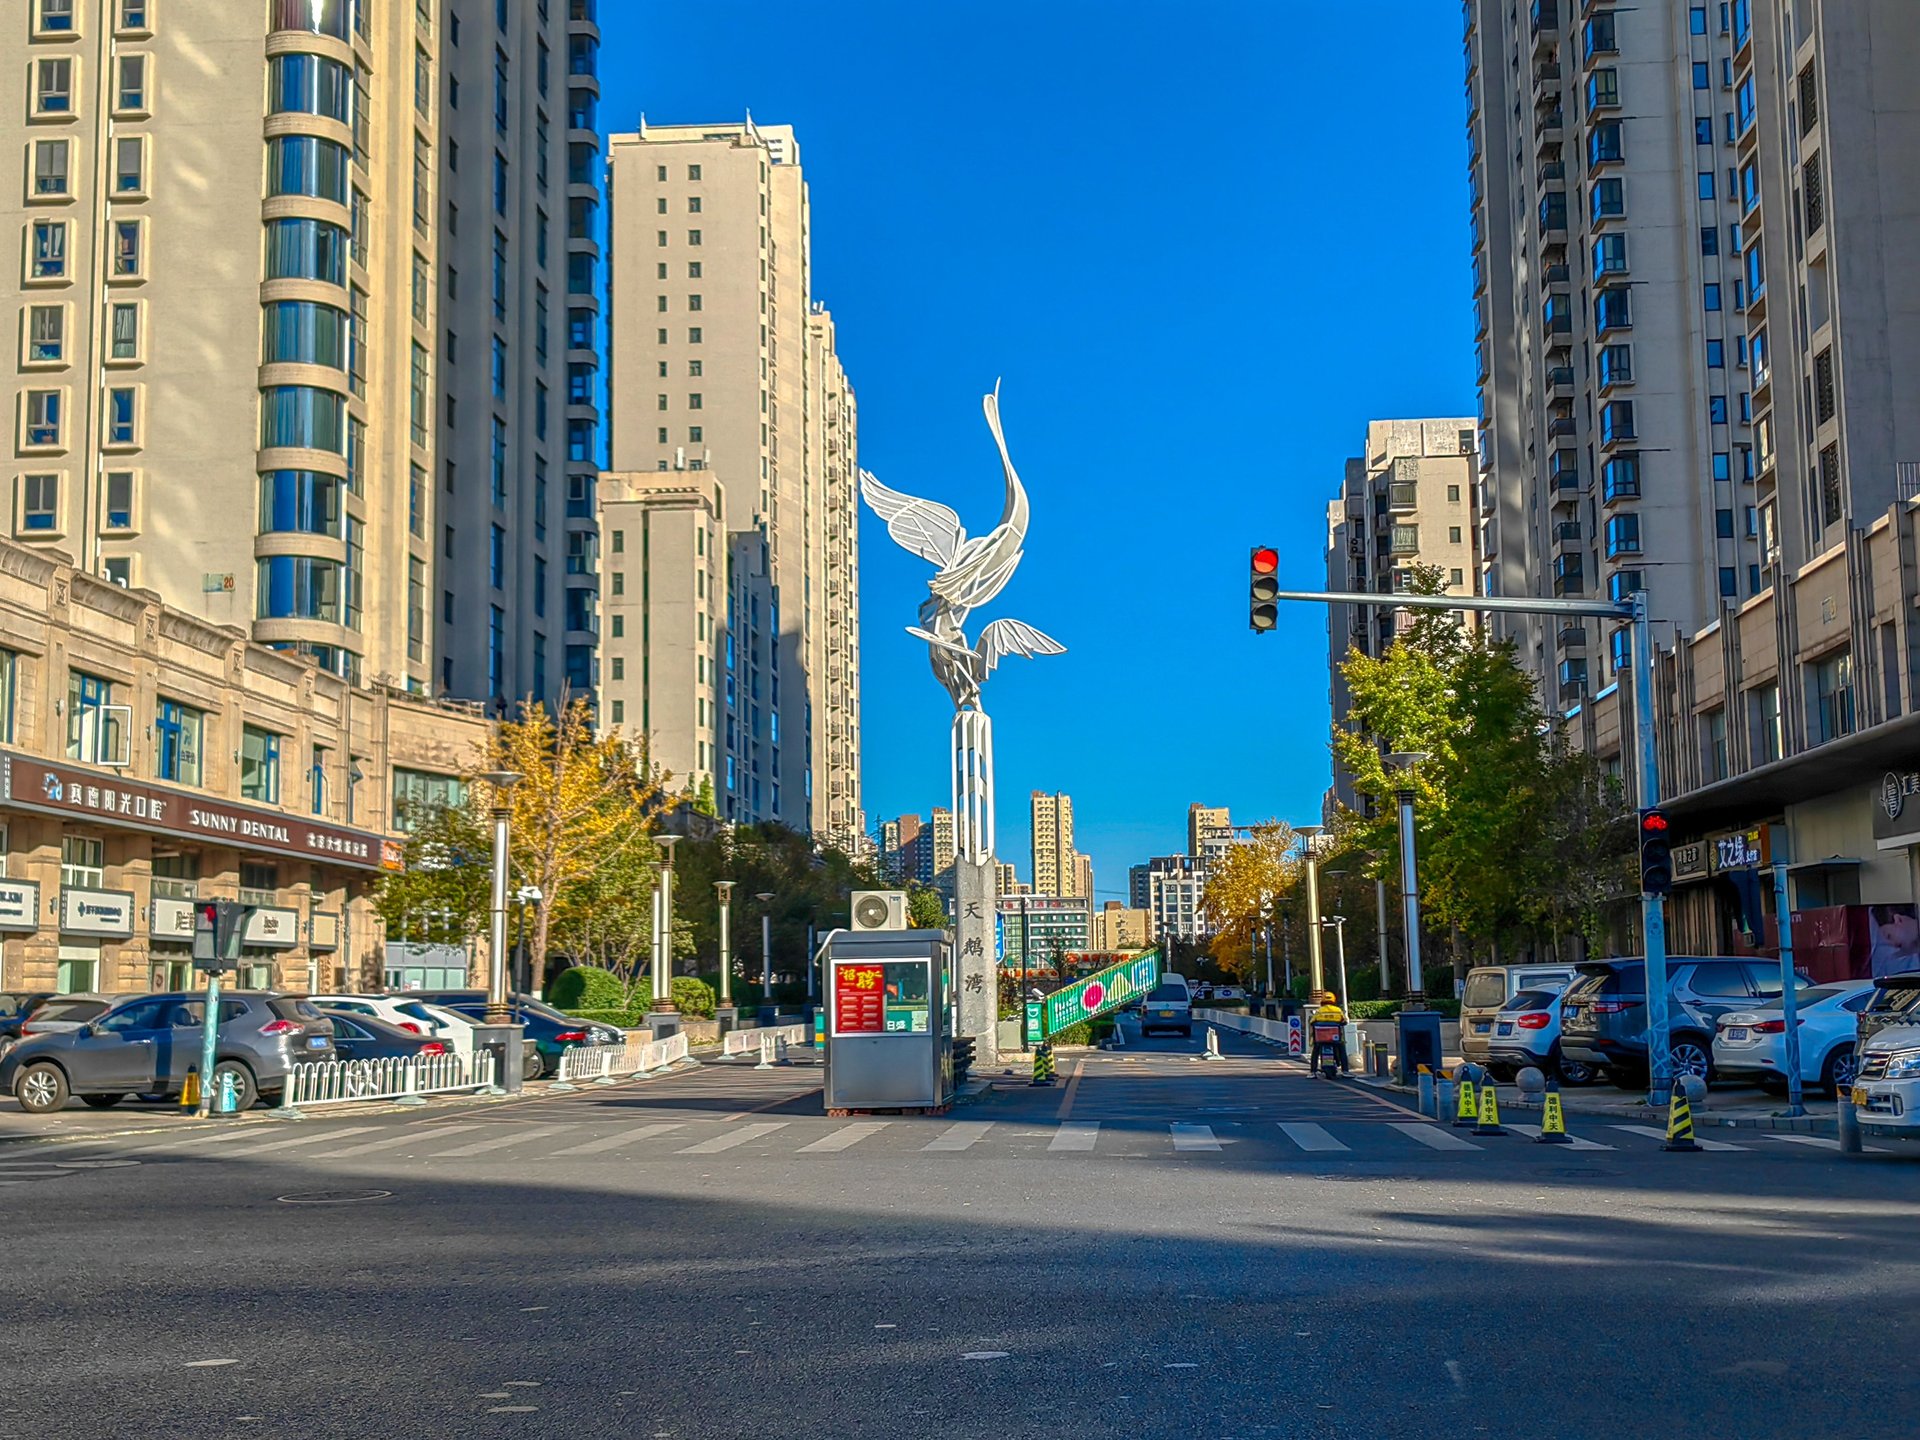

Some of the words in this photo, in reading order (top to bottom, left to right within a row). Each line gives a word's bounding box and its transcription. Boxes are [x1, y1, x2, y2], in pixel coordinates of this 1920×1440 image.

[224, 576, 234, 588] 20
[68, 783, 163, 821] 赛德阳光口腔
[190, 809, 237, 833] SUNNY
[241, 819, 290, 843] DENTAL
[963, 902, 984, 994] 天鹅湾
[843, 969, 875, 989] 招聘
[1484, 1090, 1493, 1122] 德利中天
[1548, 1097, 1558, 1131] 德利中天
